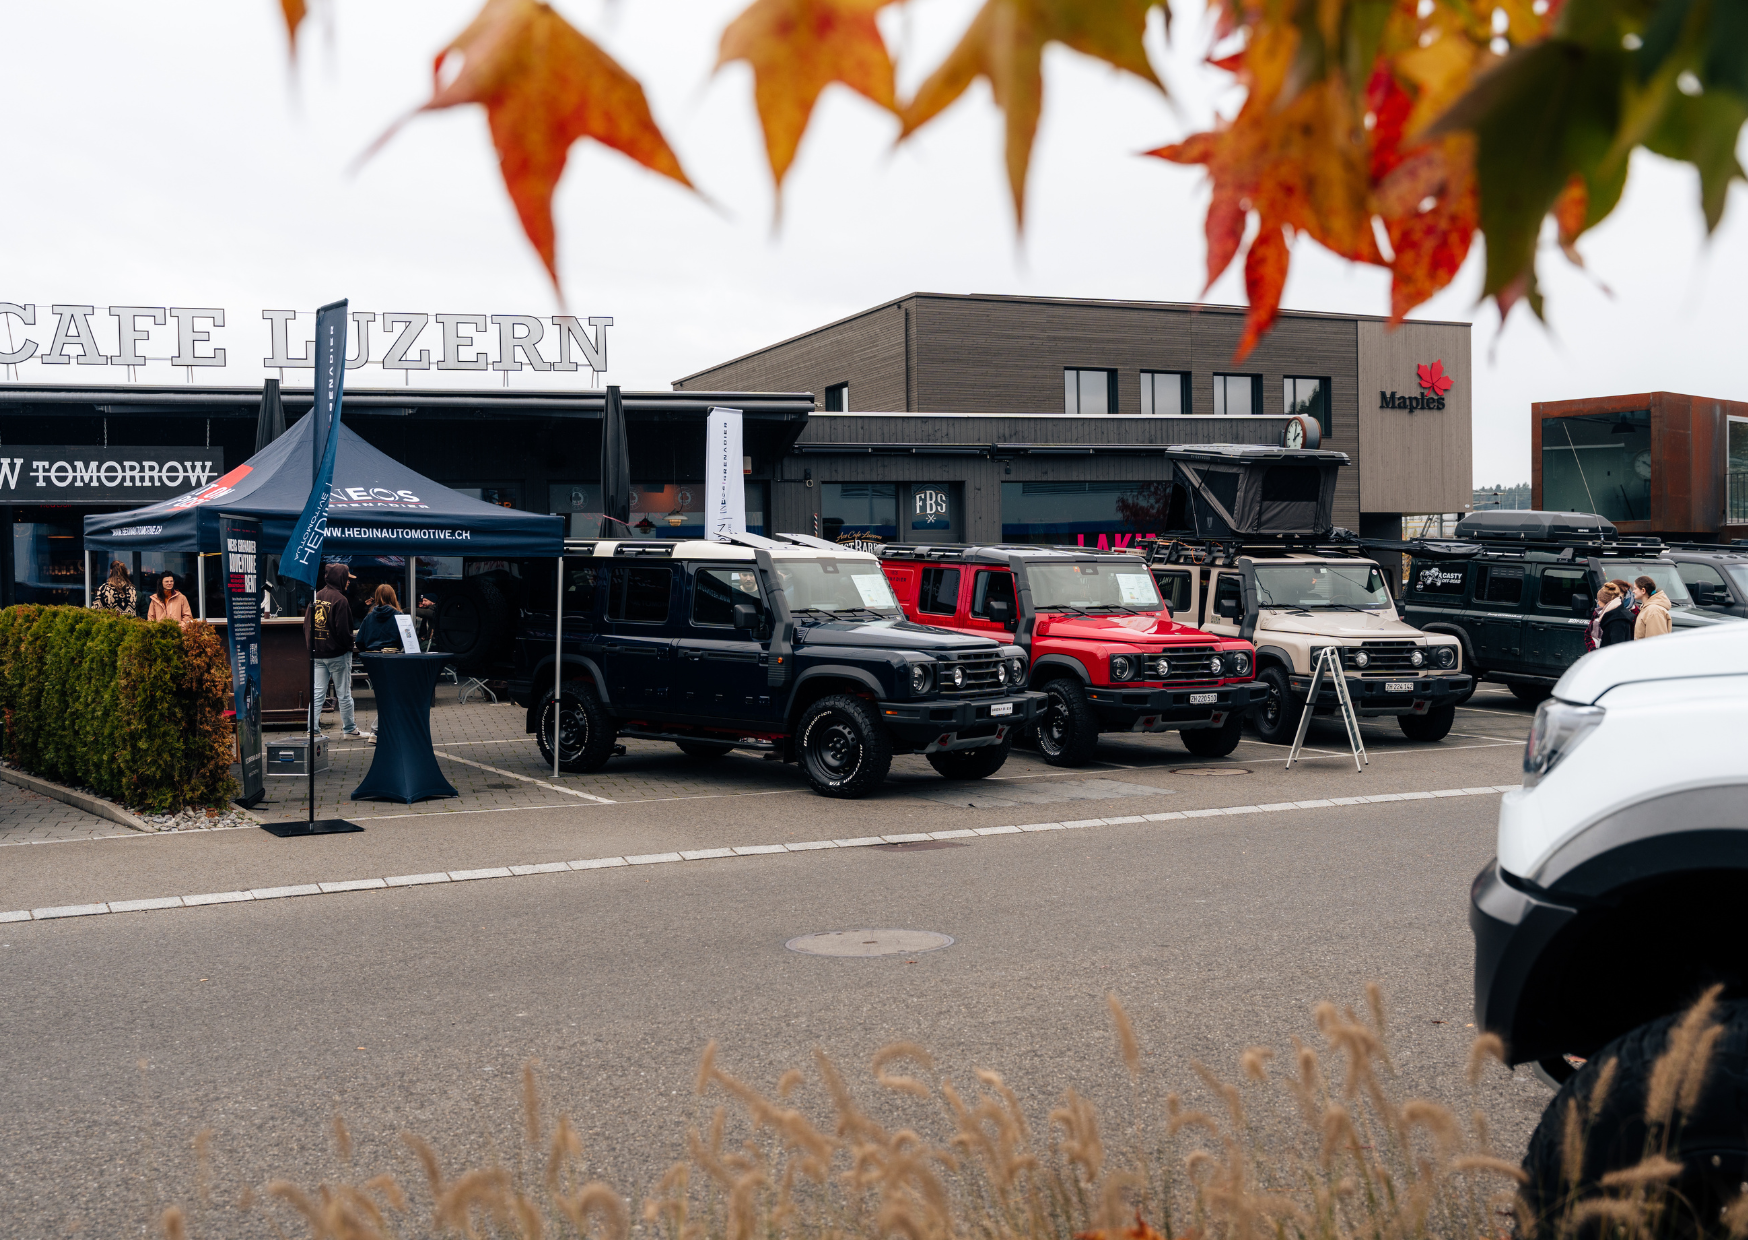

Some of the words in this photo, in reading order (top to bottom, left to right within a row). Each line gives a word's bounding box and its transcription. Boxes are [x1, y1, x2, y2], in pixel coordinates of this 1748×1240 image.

[0, 302, 226, 367] CAFE
[1379, 390, 1446, 413] Maples
[31, 460, 216, 488] TOMORROW
[330, 487, 420, 503] NEOS
[916, 490, 946, 514] FBS
[324, 527, 471, 540] WW.HEDINAUTOMOTIVE.CH
